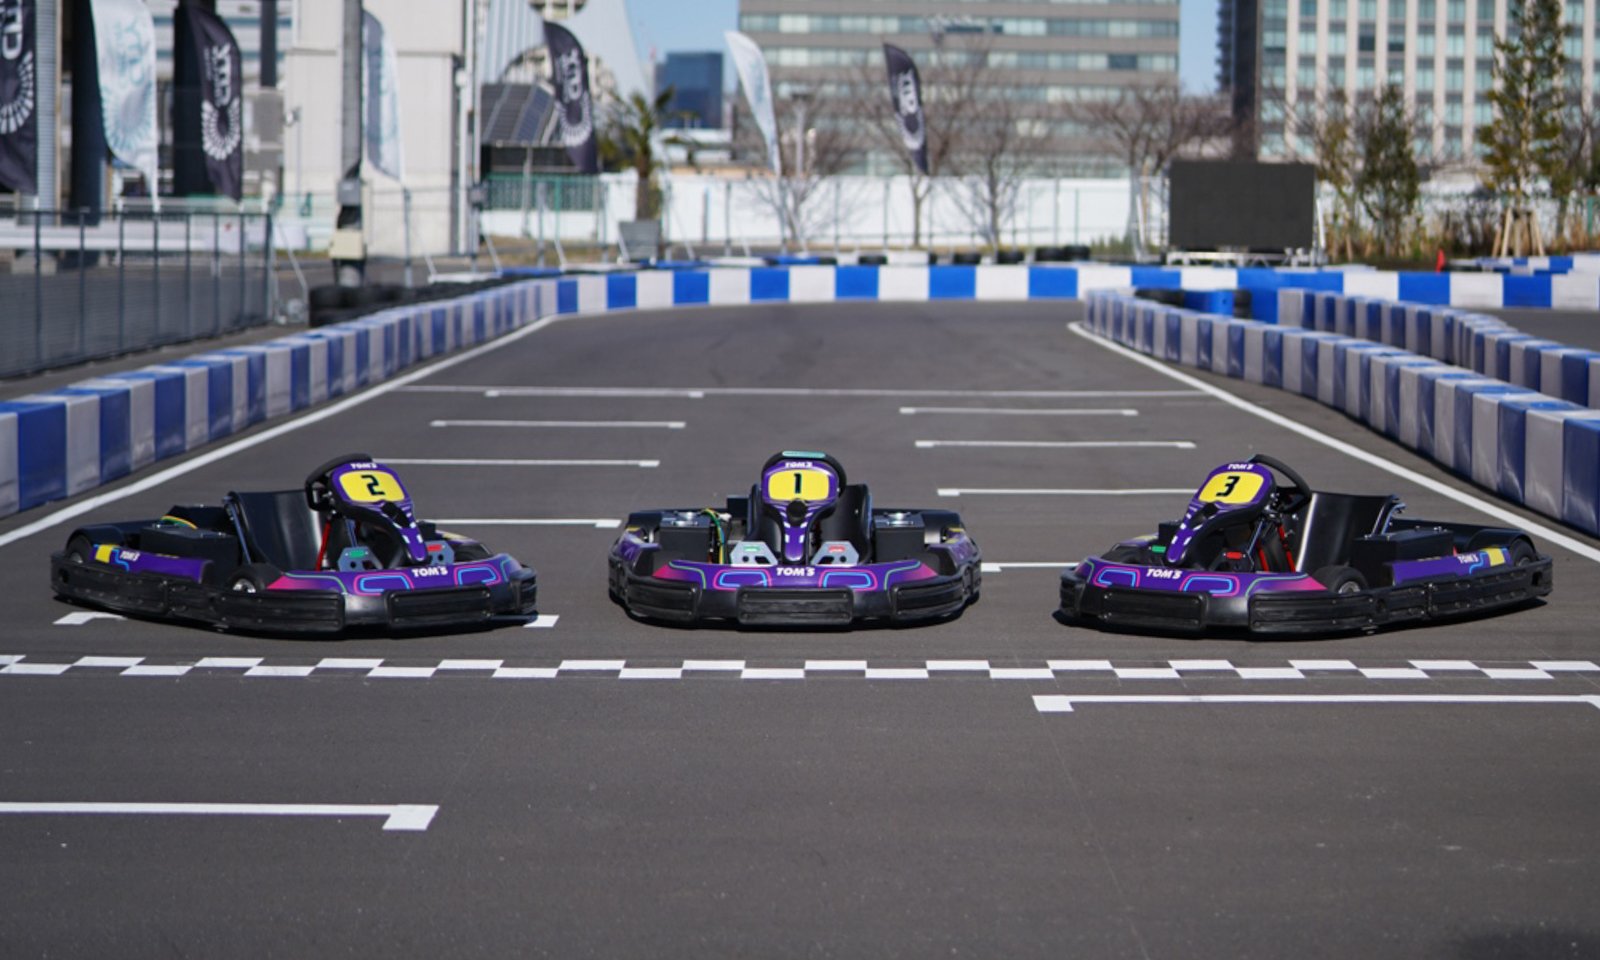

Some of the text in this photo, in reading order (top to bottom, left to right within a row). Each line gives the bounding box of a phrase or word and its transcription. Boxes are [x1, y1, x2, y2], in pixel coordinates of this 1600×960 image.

[361, 474, 386, 496] 2
[793, 473, 802, 494] 1
[1215, 475, 1240, 497] 3
[411, 566, 449, 578] TOM'S
[776, 566, 816, 577] TOM'S
[1146, 568, 1182, 580] TOM'S
